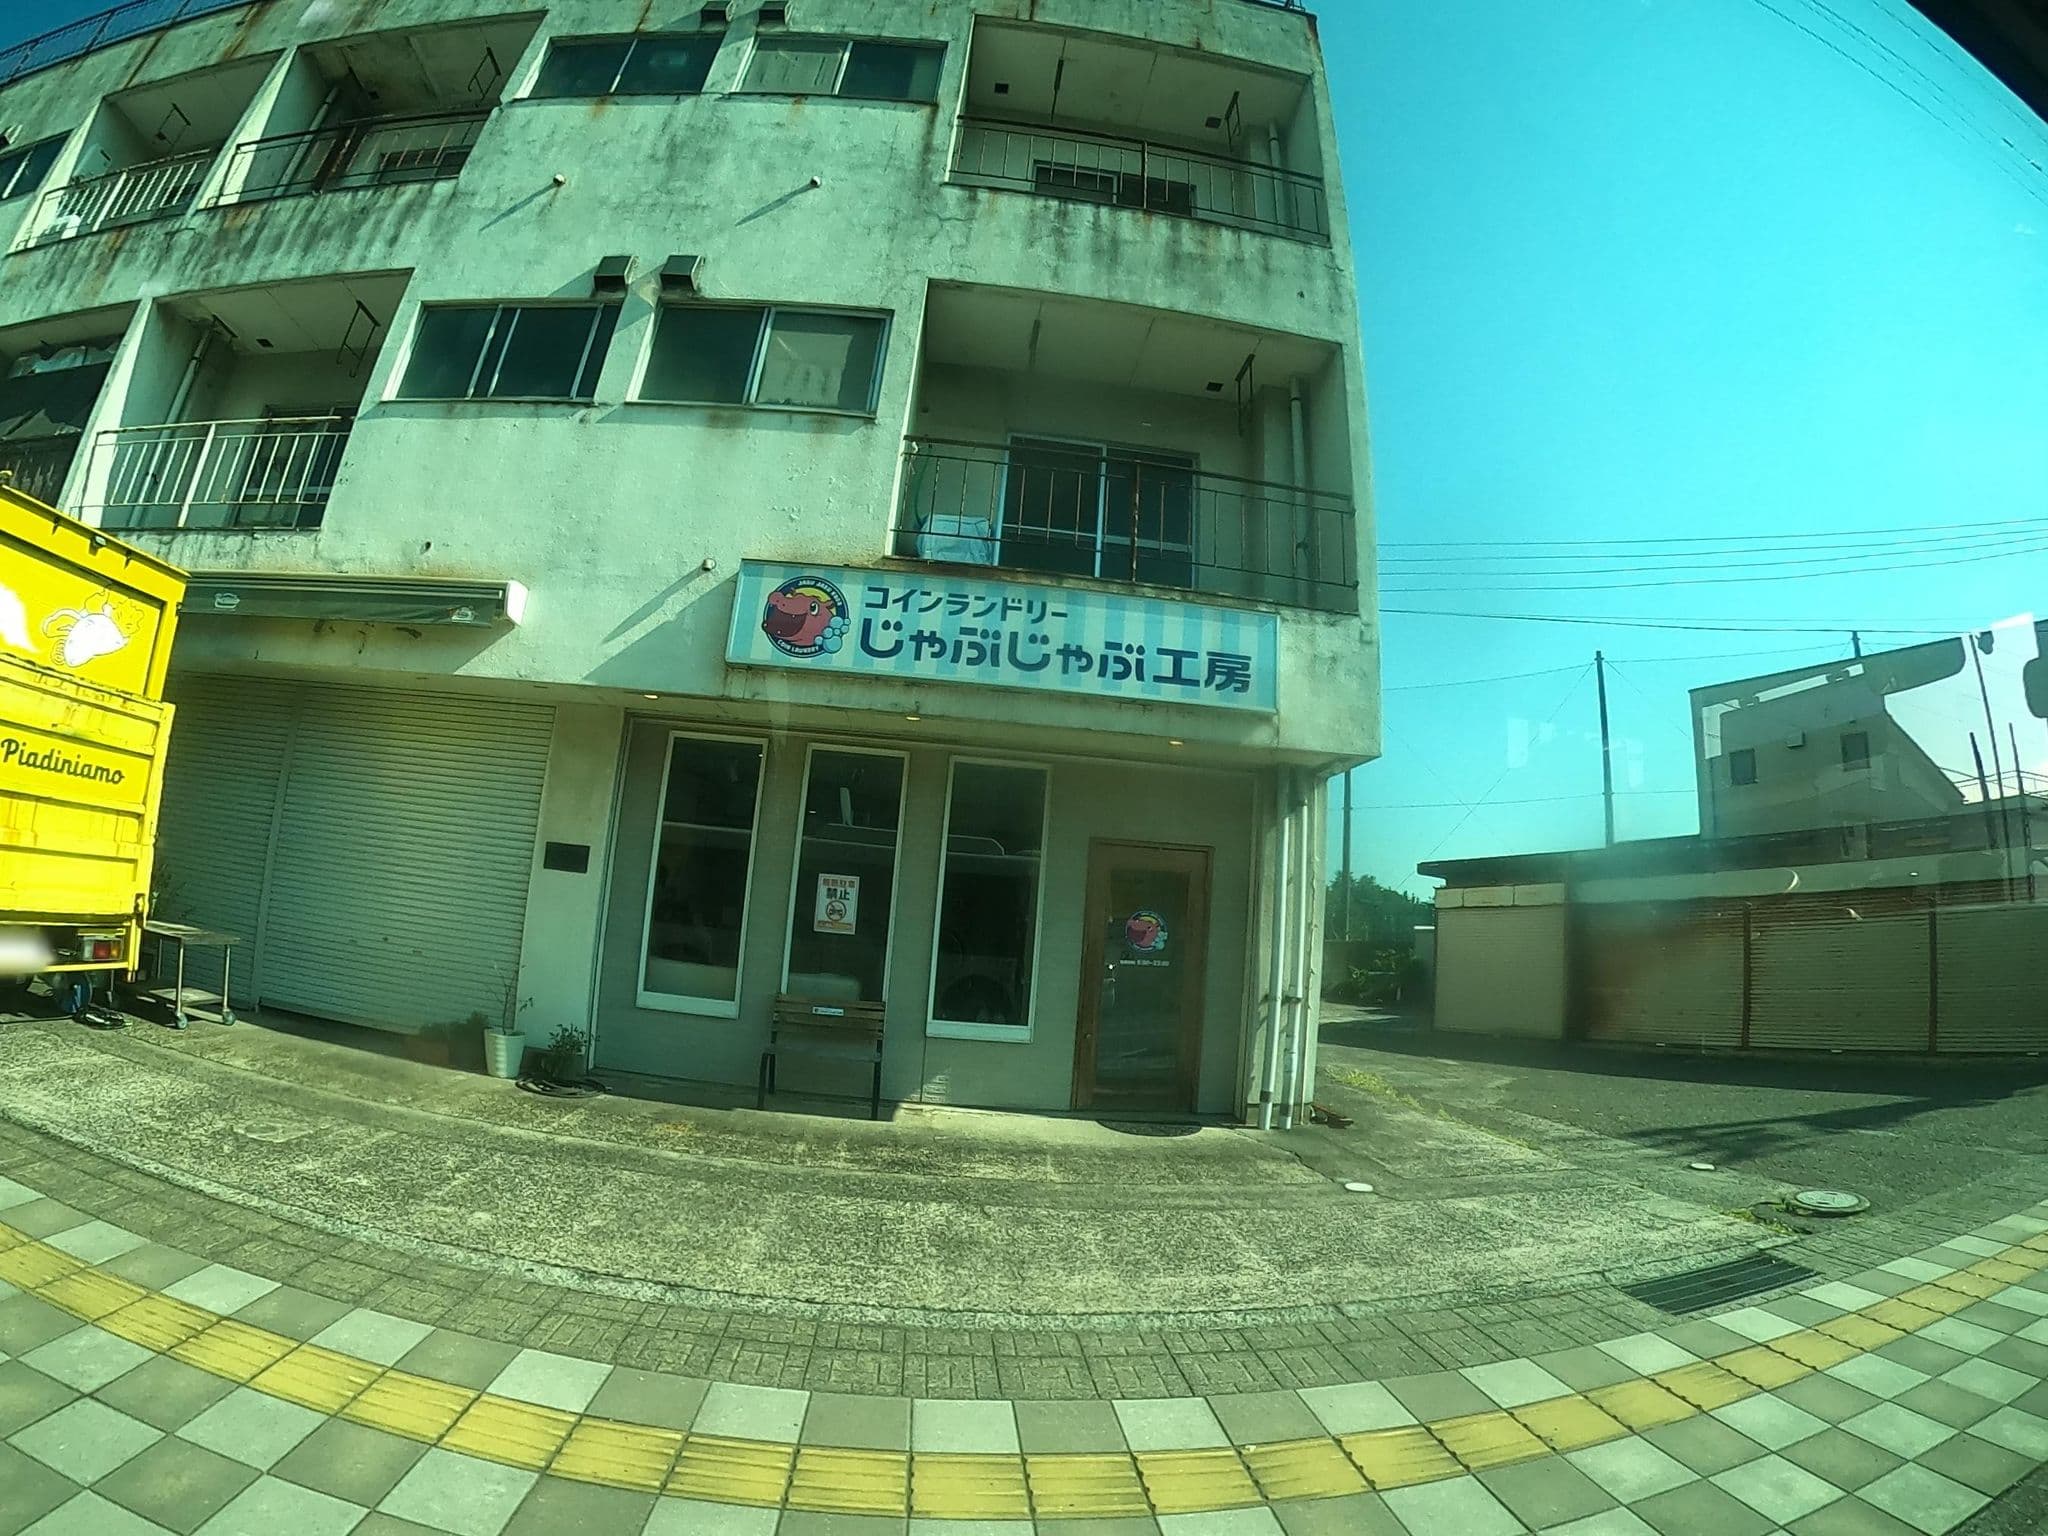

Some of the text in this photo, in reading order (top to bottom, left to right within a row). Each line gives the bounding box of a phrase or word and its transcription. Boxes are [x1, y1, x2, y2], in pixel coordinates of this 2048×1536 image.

[864, 586, 1068, 624] コインランドリー
[860, 617, 1251, 693] じゃぶじゃぶ工房
[1, 738, 125, 784] Piadiniamo
